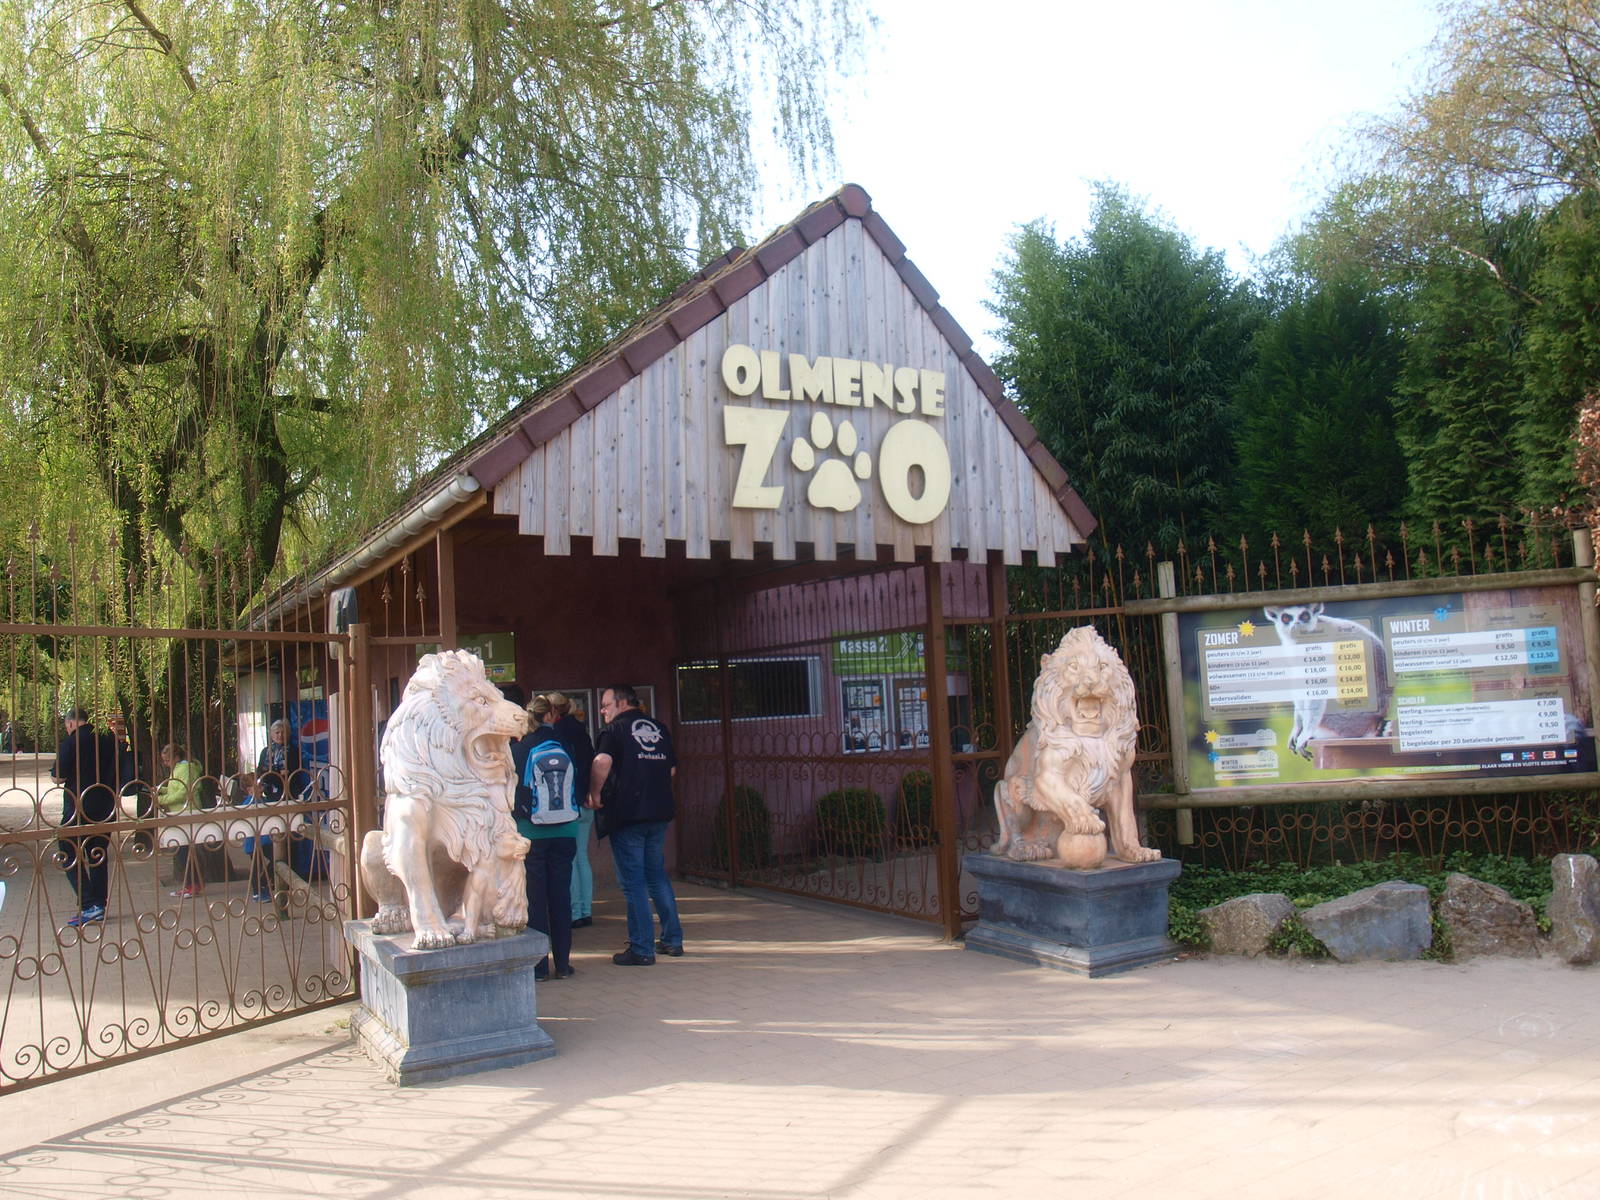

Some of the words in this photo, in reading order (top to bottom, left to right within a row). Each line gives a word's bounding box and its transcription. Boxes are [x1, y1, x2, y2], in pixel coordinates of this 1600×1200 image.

[721, 343, 945, 417] OLMENSE
[1389, 618, 1430, 634] WINTER
[840, 640, 877, 654] Kassa
[879, 636, 888, 652] 2
[1204, 632, 1239, 646] ZOMER
[1305, 644, 1322, 652] gratis
[1536, 651, 1554, 659] 12,50
